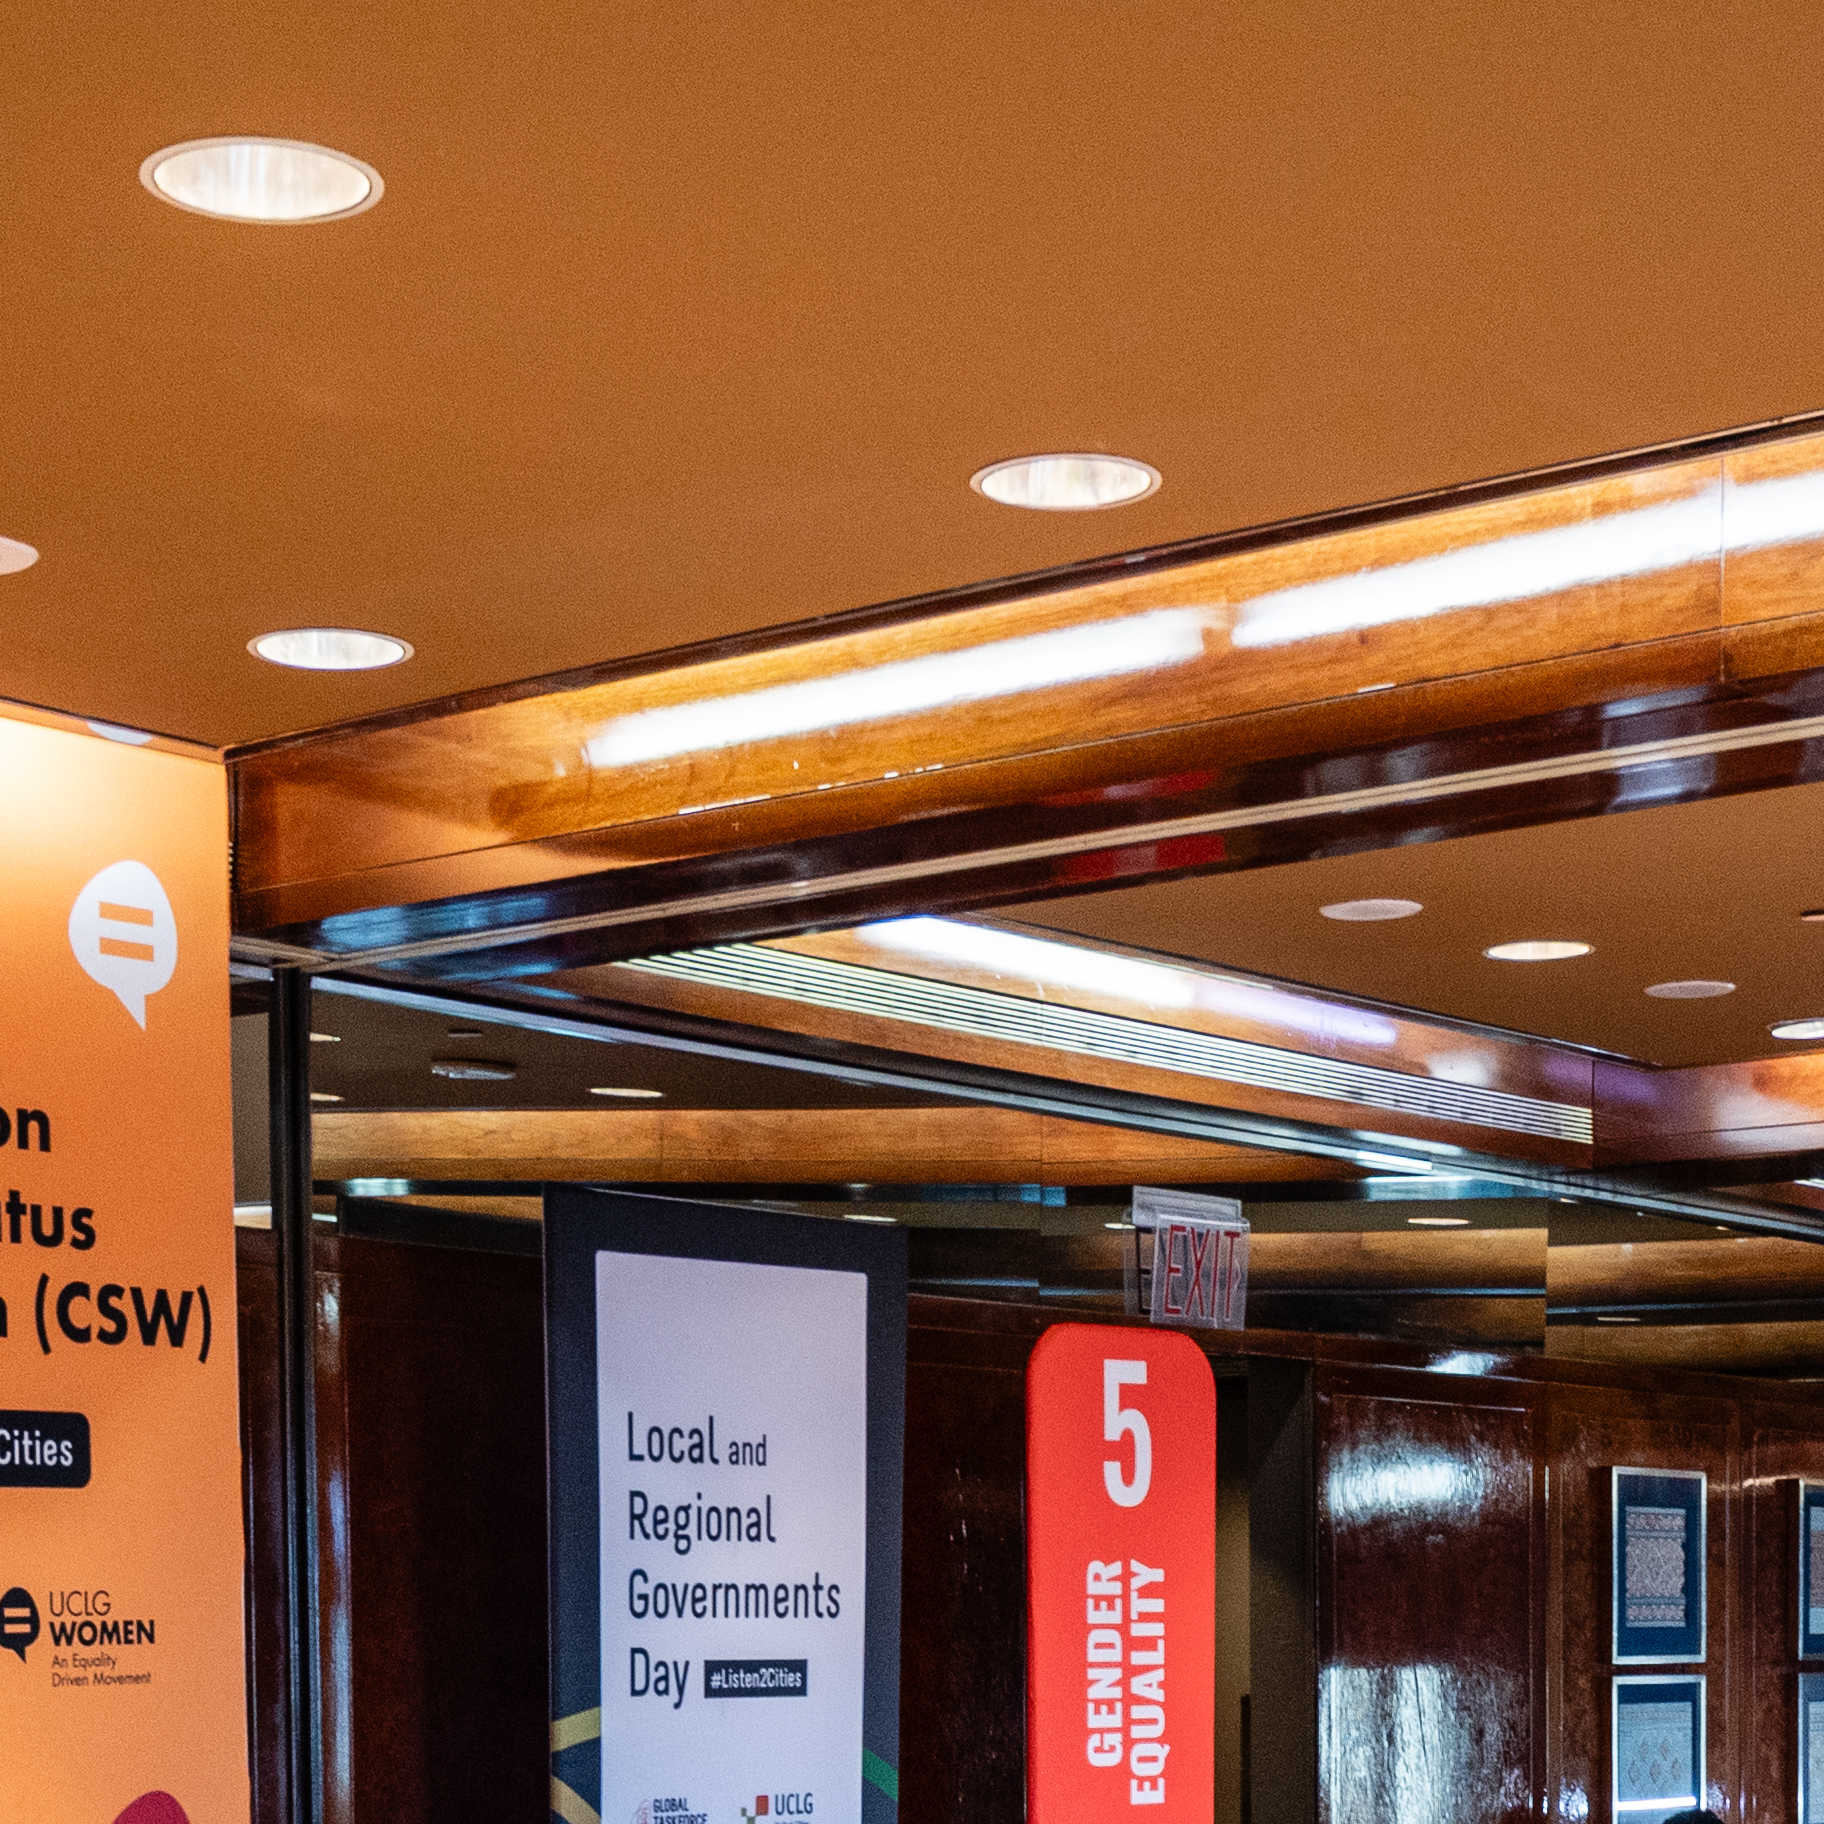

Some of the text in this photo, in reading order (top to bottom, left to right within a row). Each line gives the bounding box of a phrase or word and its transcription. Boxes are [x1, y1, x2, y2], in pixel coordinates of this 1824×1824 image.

[1164, 1224, 1241, 1319] EXIT
[34, 1272, 212, 1365] (CSW)
[628, 1411, 767, 1467] Local and
[1103, 1359, 1152, 1508] 5
[628, 1489, 776, 1556] Regional
[50, 1590, 111, 1617] UCLG
[628, 1568, 841, 1619] Governments
[50, 1619, 155, 1647] WOMEN
[51, 1653, 117, 1673] An Equality
[52, 1670, 151, 1688] Driven Movement
[630, 1646, 803, 1710] Day #Listen2Cities
[1086, 1558, 1123, 1768] GENDER
[1130, 1559, 1166, 1805] EQUALITY
[652, 1797, 690, 1814] GLOBAL
[774, 1793, 814, 1816] UCLG
